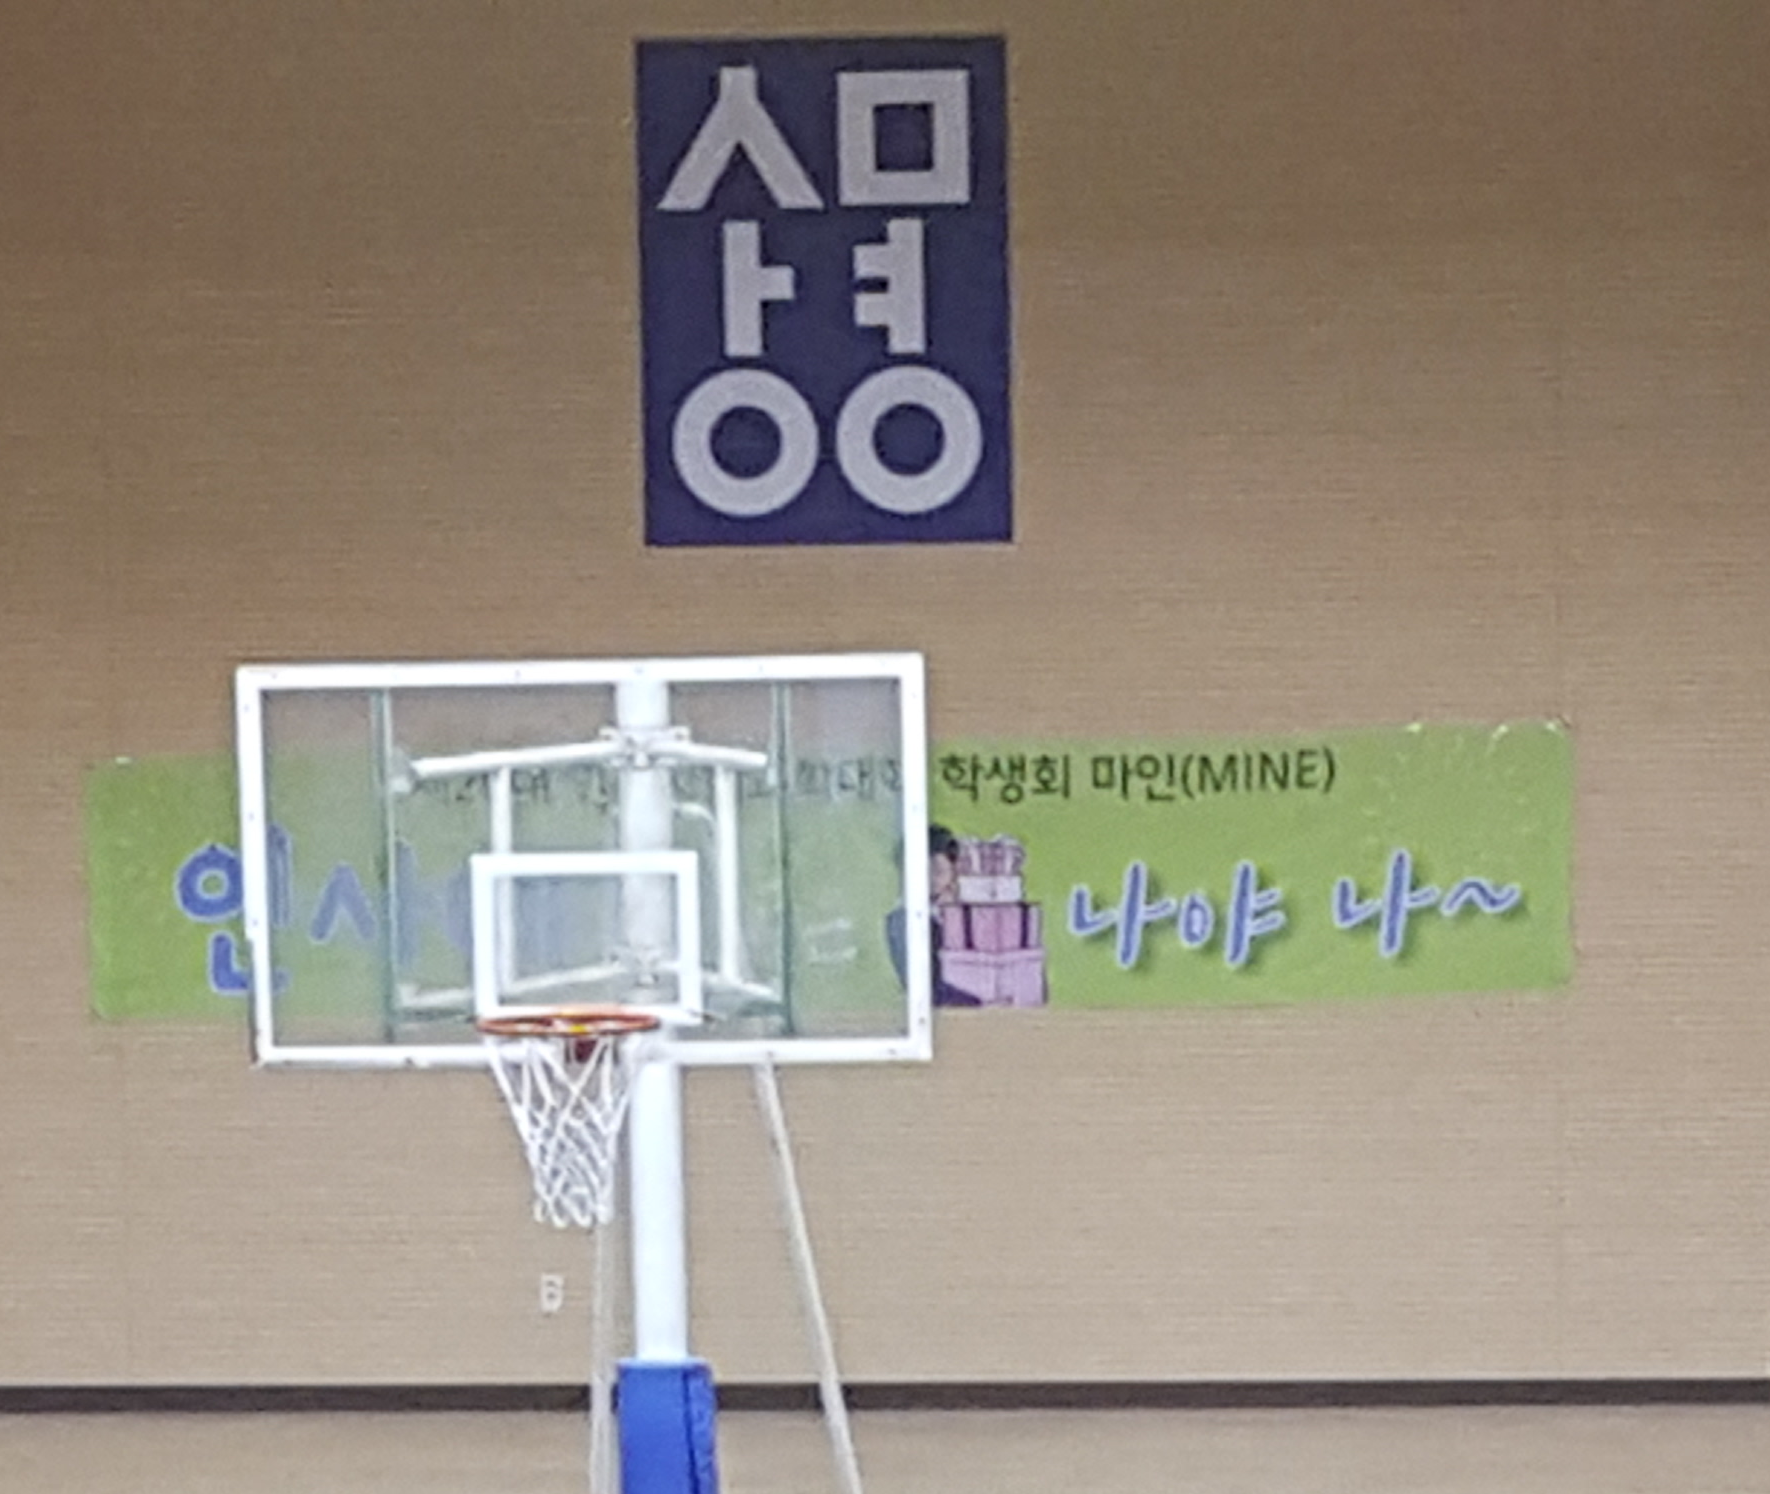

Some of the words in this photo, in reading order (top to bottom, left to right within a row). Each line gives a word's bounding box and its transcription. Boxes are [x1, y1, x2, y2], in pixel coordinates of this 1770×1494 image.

[657, 66, 983, 516] 상명
[940, 752, 1072, 805] 학생회
[1090, 747, 1337, 803] 마인(MINE)
[1067, 860, 1287, 970] 나야
